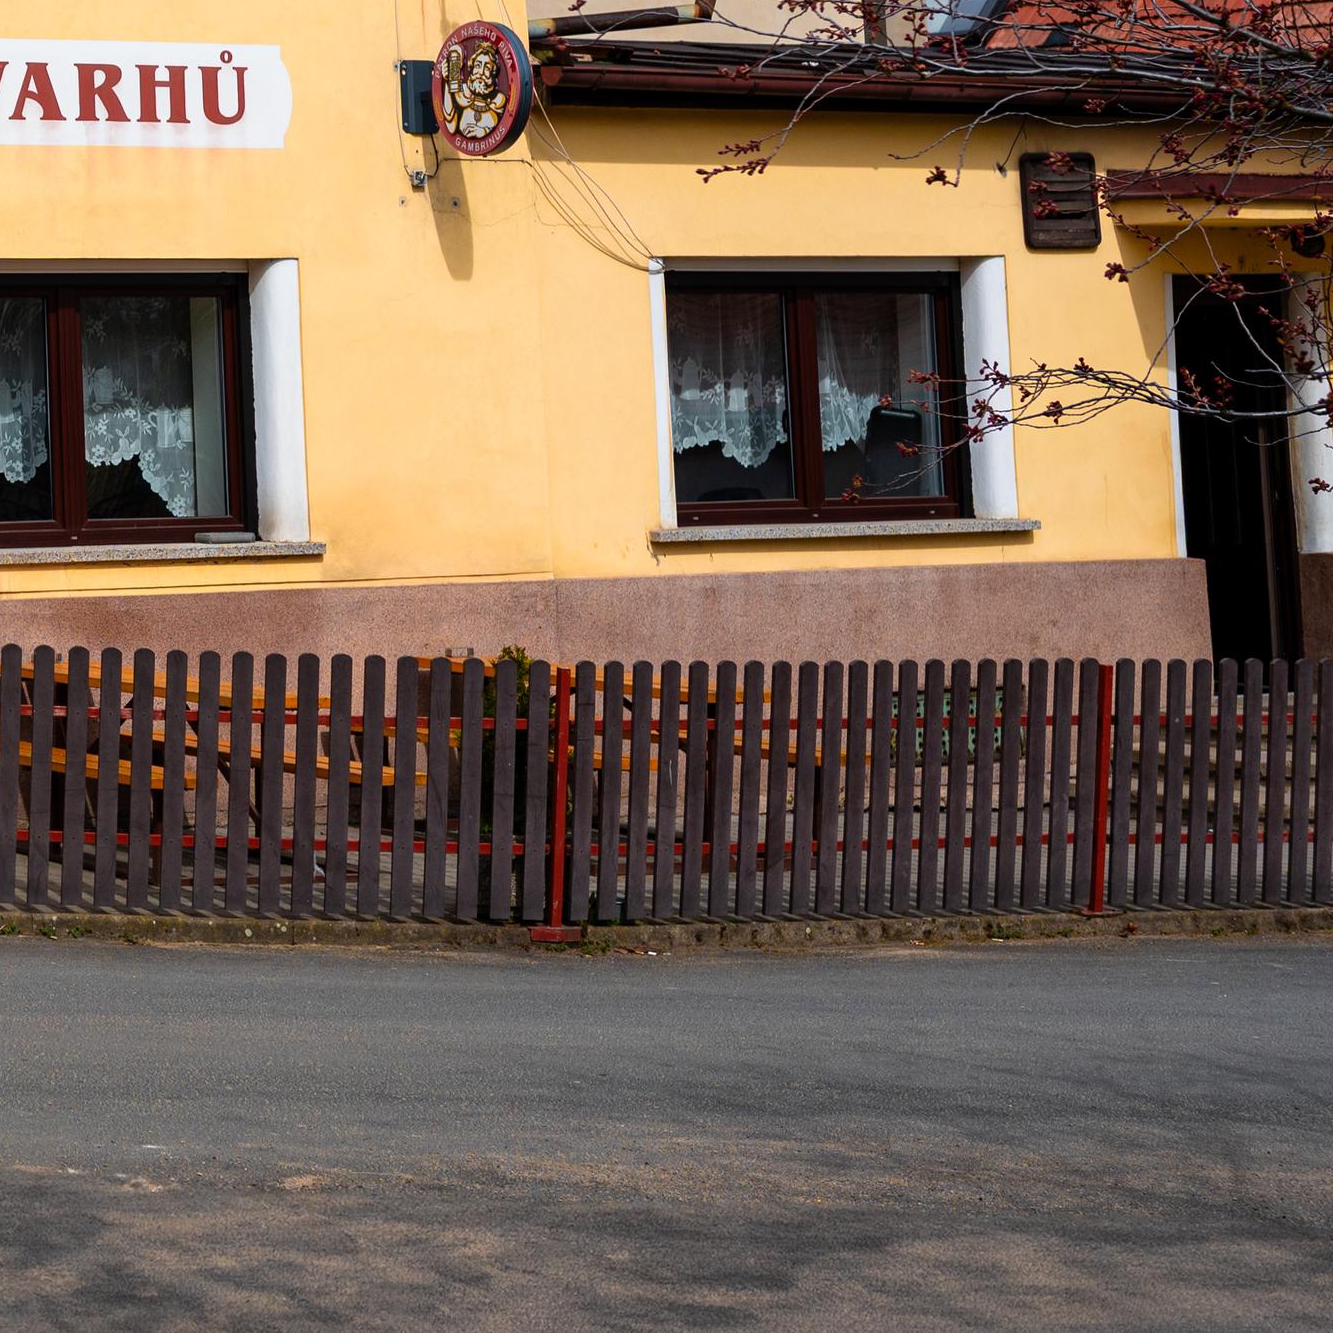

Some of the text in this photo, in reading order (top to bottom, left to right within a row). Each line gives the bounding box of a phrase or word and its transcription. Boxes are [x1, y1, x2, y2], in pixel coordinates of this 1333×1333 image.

[435, 23, 512, 78] PATRON NAŠEHO PIVA
[455, 126, 506, 152] GAMBRINUS
